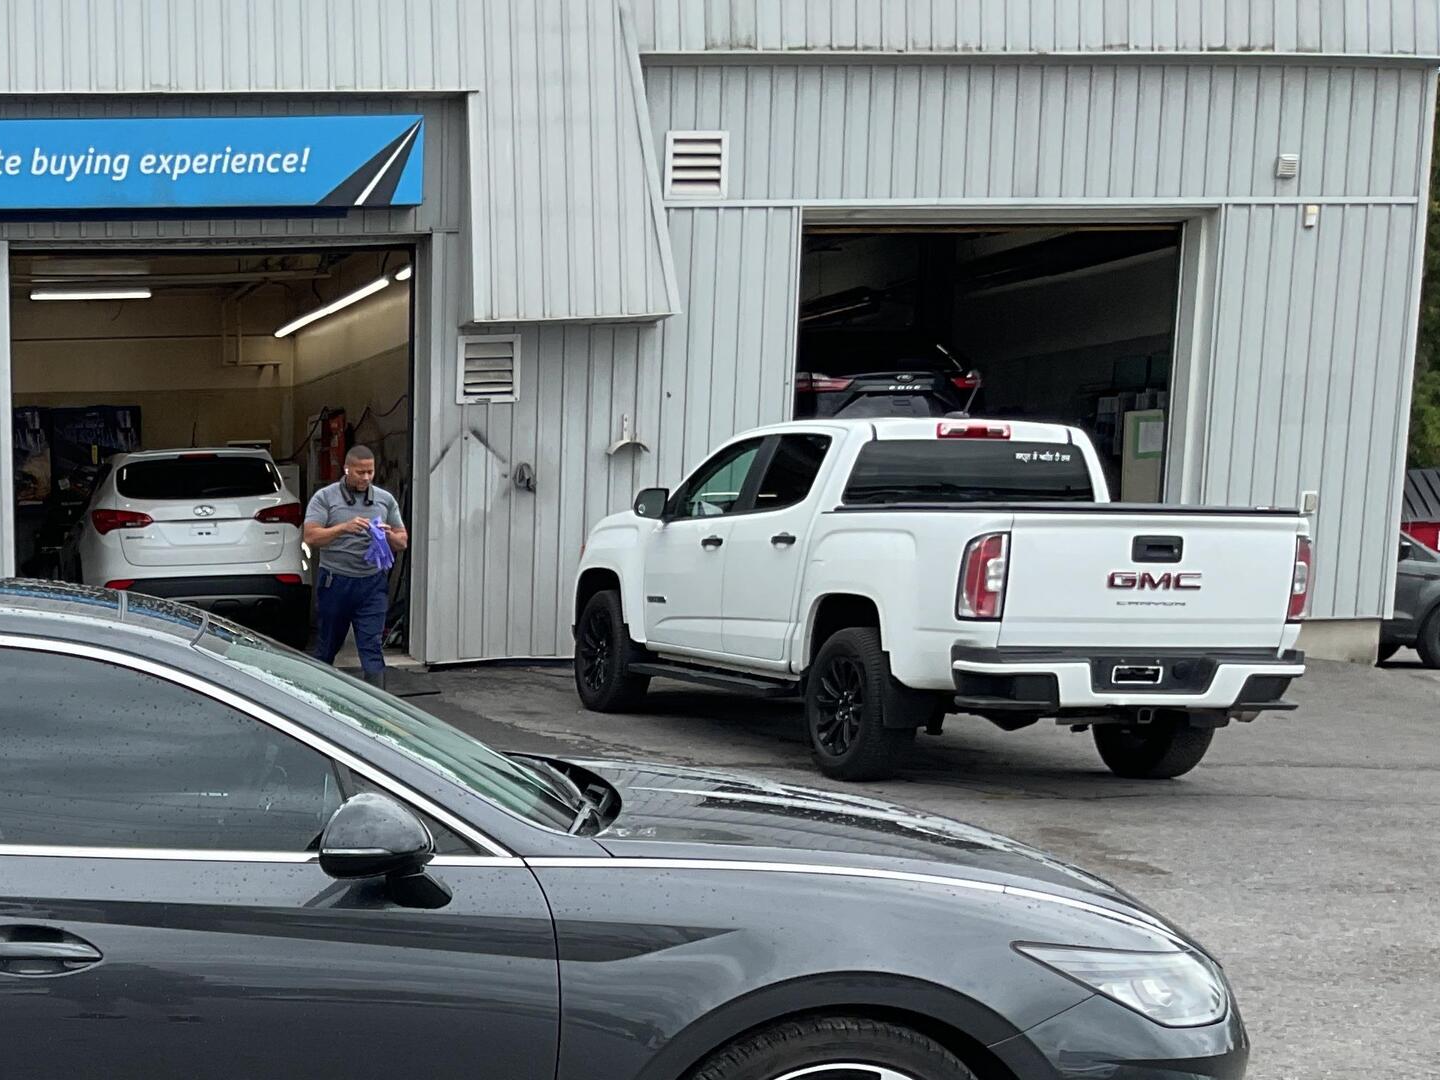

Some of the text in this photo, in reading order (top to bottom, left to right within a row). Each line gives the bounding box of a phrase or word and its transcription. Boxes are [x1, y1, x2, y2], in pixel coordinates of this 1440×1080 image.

[30, 147, 130, 182] buying
[139, 146, 311, 181] experience!
[1106, 570, 1202, 592] GMC
